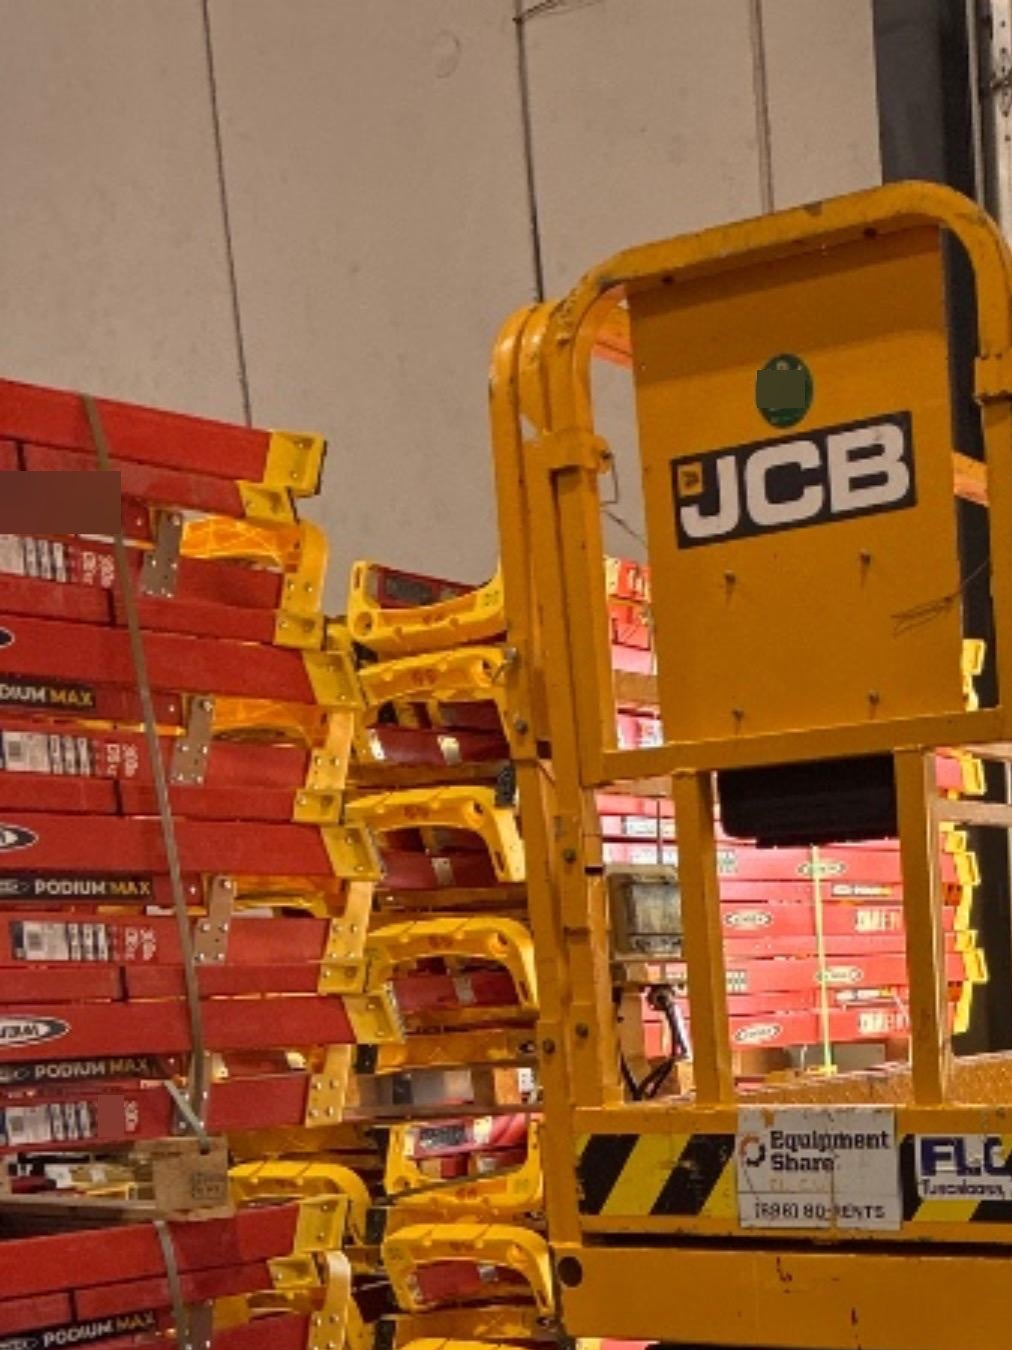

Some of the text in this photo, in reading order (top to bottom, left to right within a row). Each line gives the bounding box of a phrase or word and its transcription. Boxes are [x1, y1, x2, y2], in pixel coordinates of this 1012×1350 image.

[679, 422, 911, 539] JCB
[49, 688, 94, 706] MAX
[34, 879, 106, 895] PODIUM
[109, 881, 151, 895] MAX
[34, 1061, 106, 1079] PODIUM
[770, 1130, 890, 1153] Equipment
[770, 1153, 835, 1172] Share
